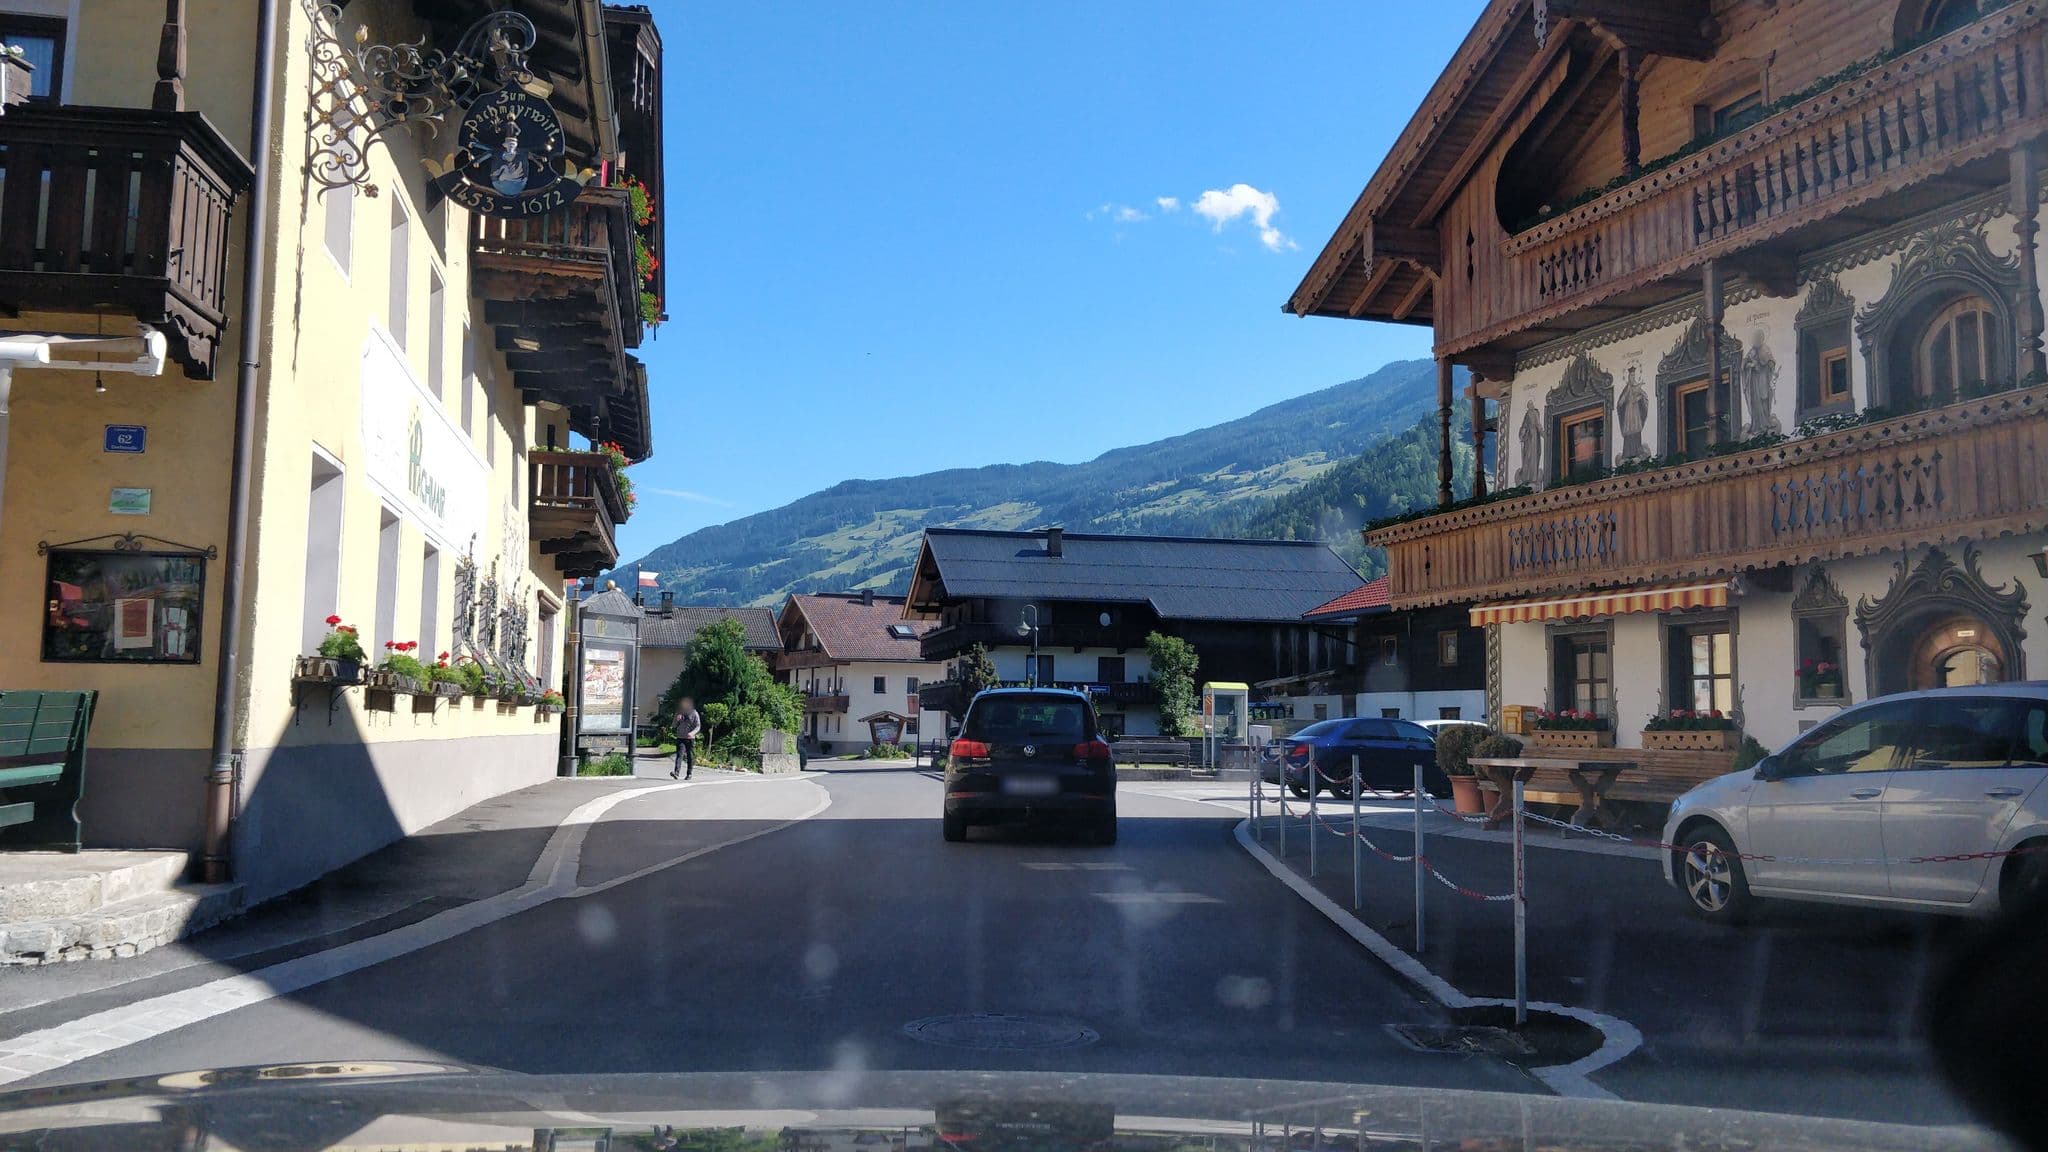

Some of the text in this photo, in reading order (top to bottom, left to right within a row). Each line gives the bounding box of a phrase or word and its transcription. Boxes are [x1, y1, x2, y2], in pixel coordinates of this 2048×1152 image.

[496, 90, 526, 104] Zum
[450, 182, 495, 213] 1453
[117, 434, 133, 444] 62
